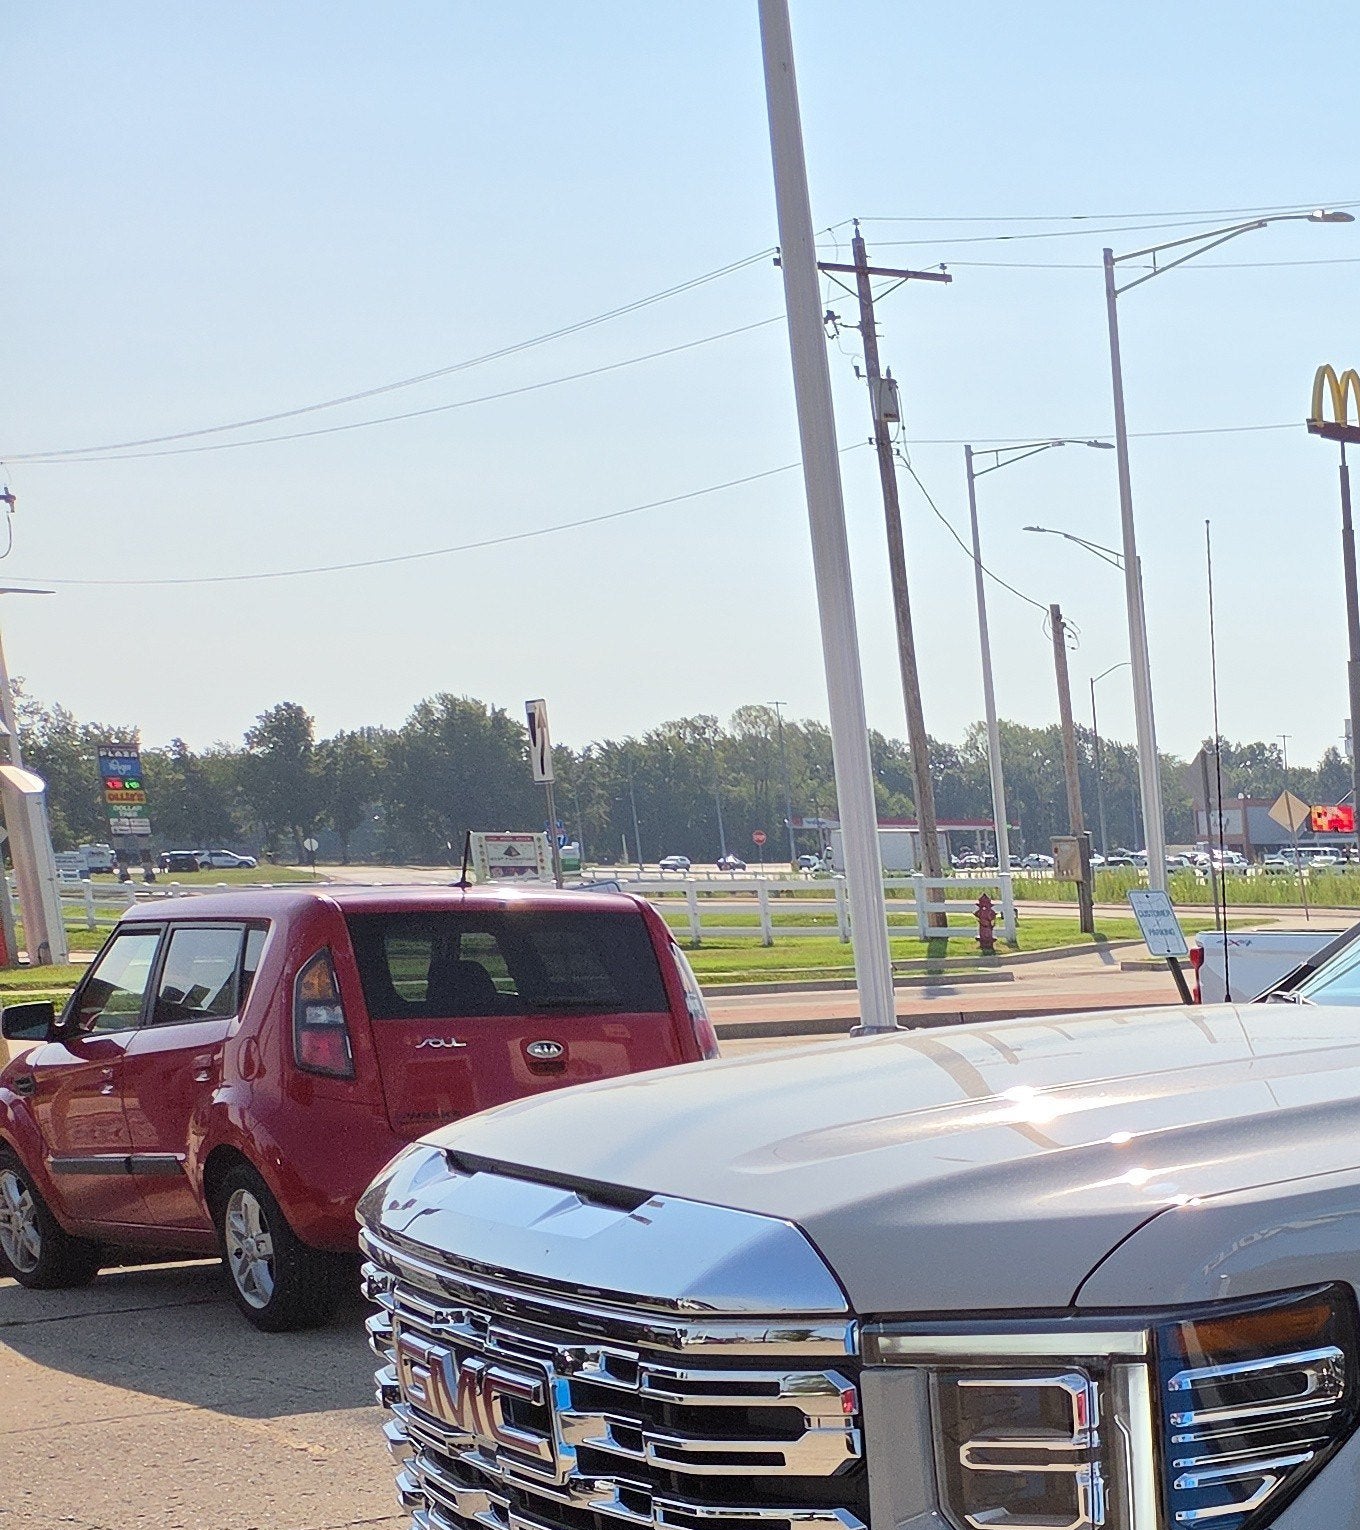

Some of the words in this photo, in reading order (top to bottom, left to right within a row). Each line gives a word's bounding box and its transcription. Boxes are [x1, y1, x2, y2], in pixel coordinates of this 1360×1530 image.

[1138, 909, 1171, 917] CUSTOMER
[415, 1037, 467, 1049] SOUL
[534, 1045, 559, 1053] KIA
[400, 1331, 553, 1462] GMC
